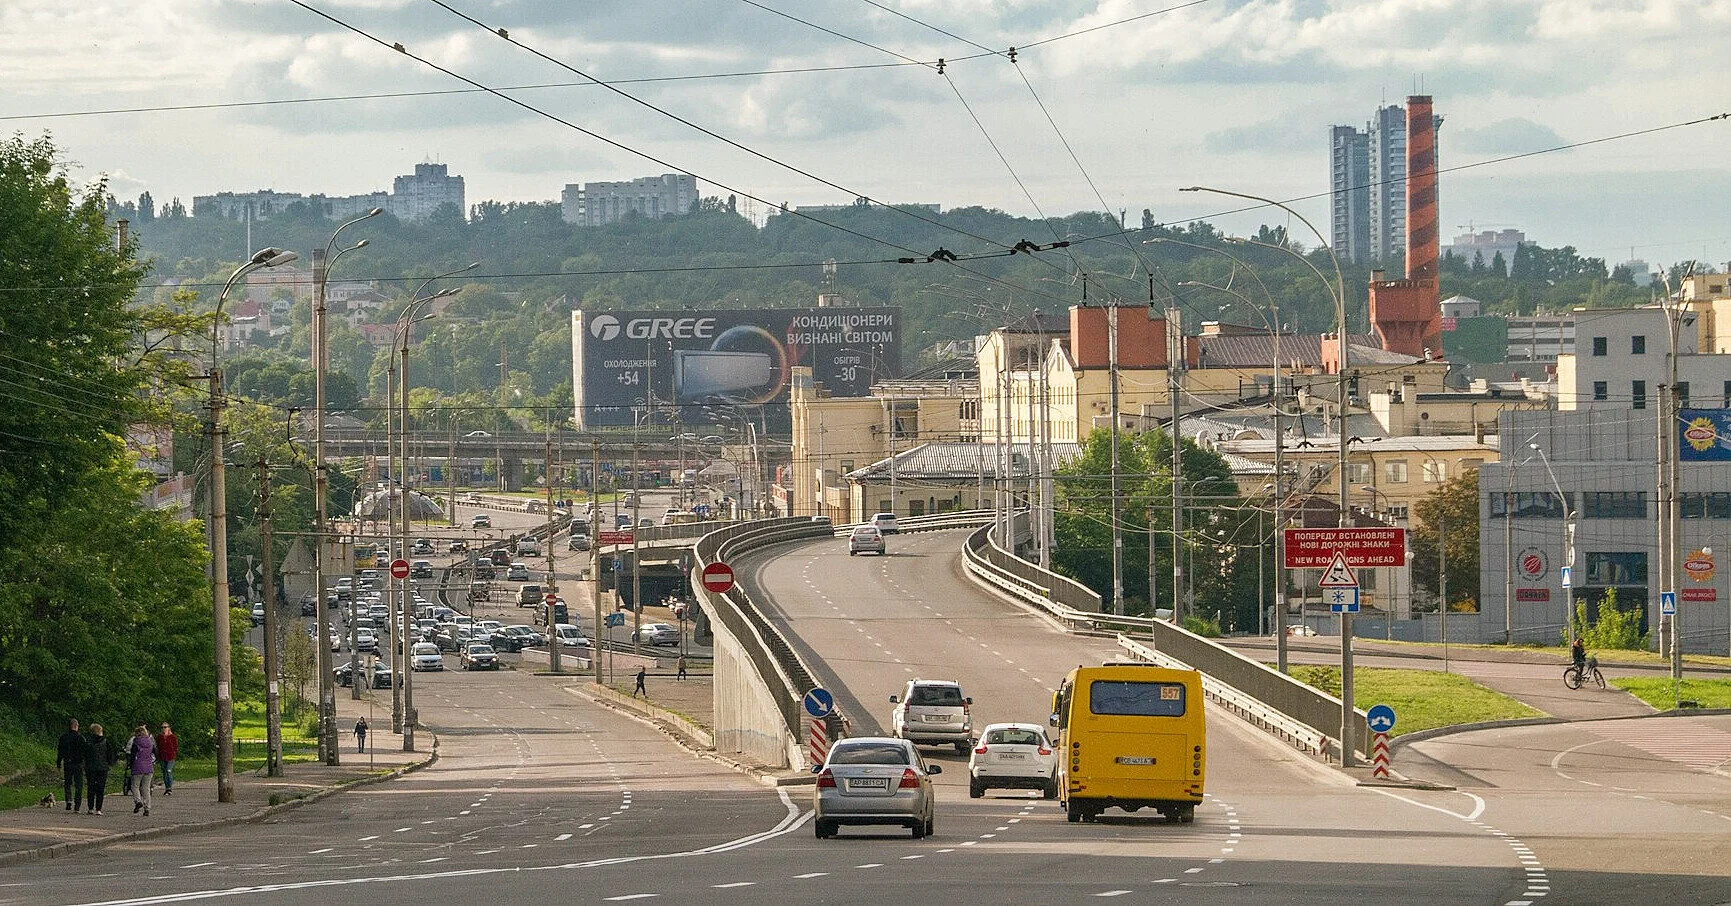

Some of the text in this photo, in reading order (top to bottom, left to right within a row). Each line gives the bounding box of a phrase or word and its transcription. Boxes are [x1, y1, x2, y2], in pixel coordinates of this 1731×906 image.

[626, 317, 716, 339] GREE
[793, 314, 893, 330] КОНДИЦІОНЕРИ
[787, 331, 893, 345] ВИЗНАНІ СВІТОМ
[833, 356, 860, 365] ОБІГРІВ
[617, 371, 639, 386] +54
[1294, 531, 1395, 541] ПОПЕРЕДУ ВСТАНОВЛЕНІ
[1300, 540, 1390, 550] НОВІ ДОРОЖНІ ЗНАКИ
[1295, 555, 1395, 564] NEW ROA IGNS AHEAD
